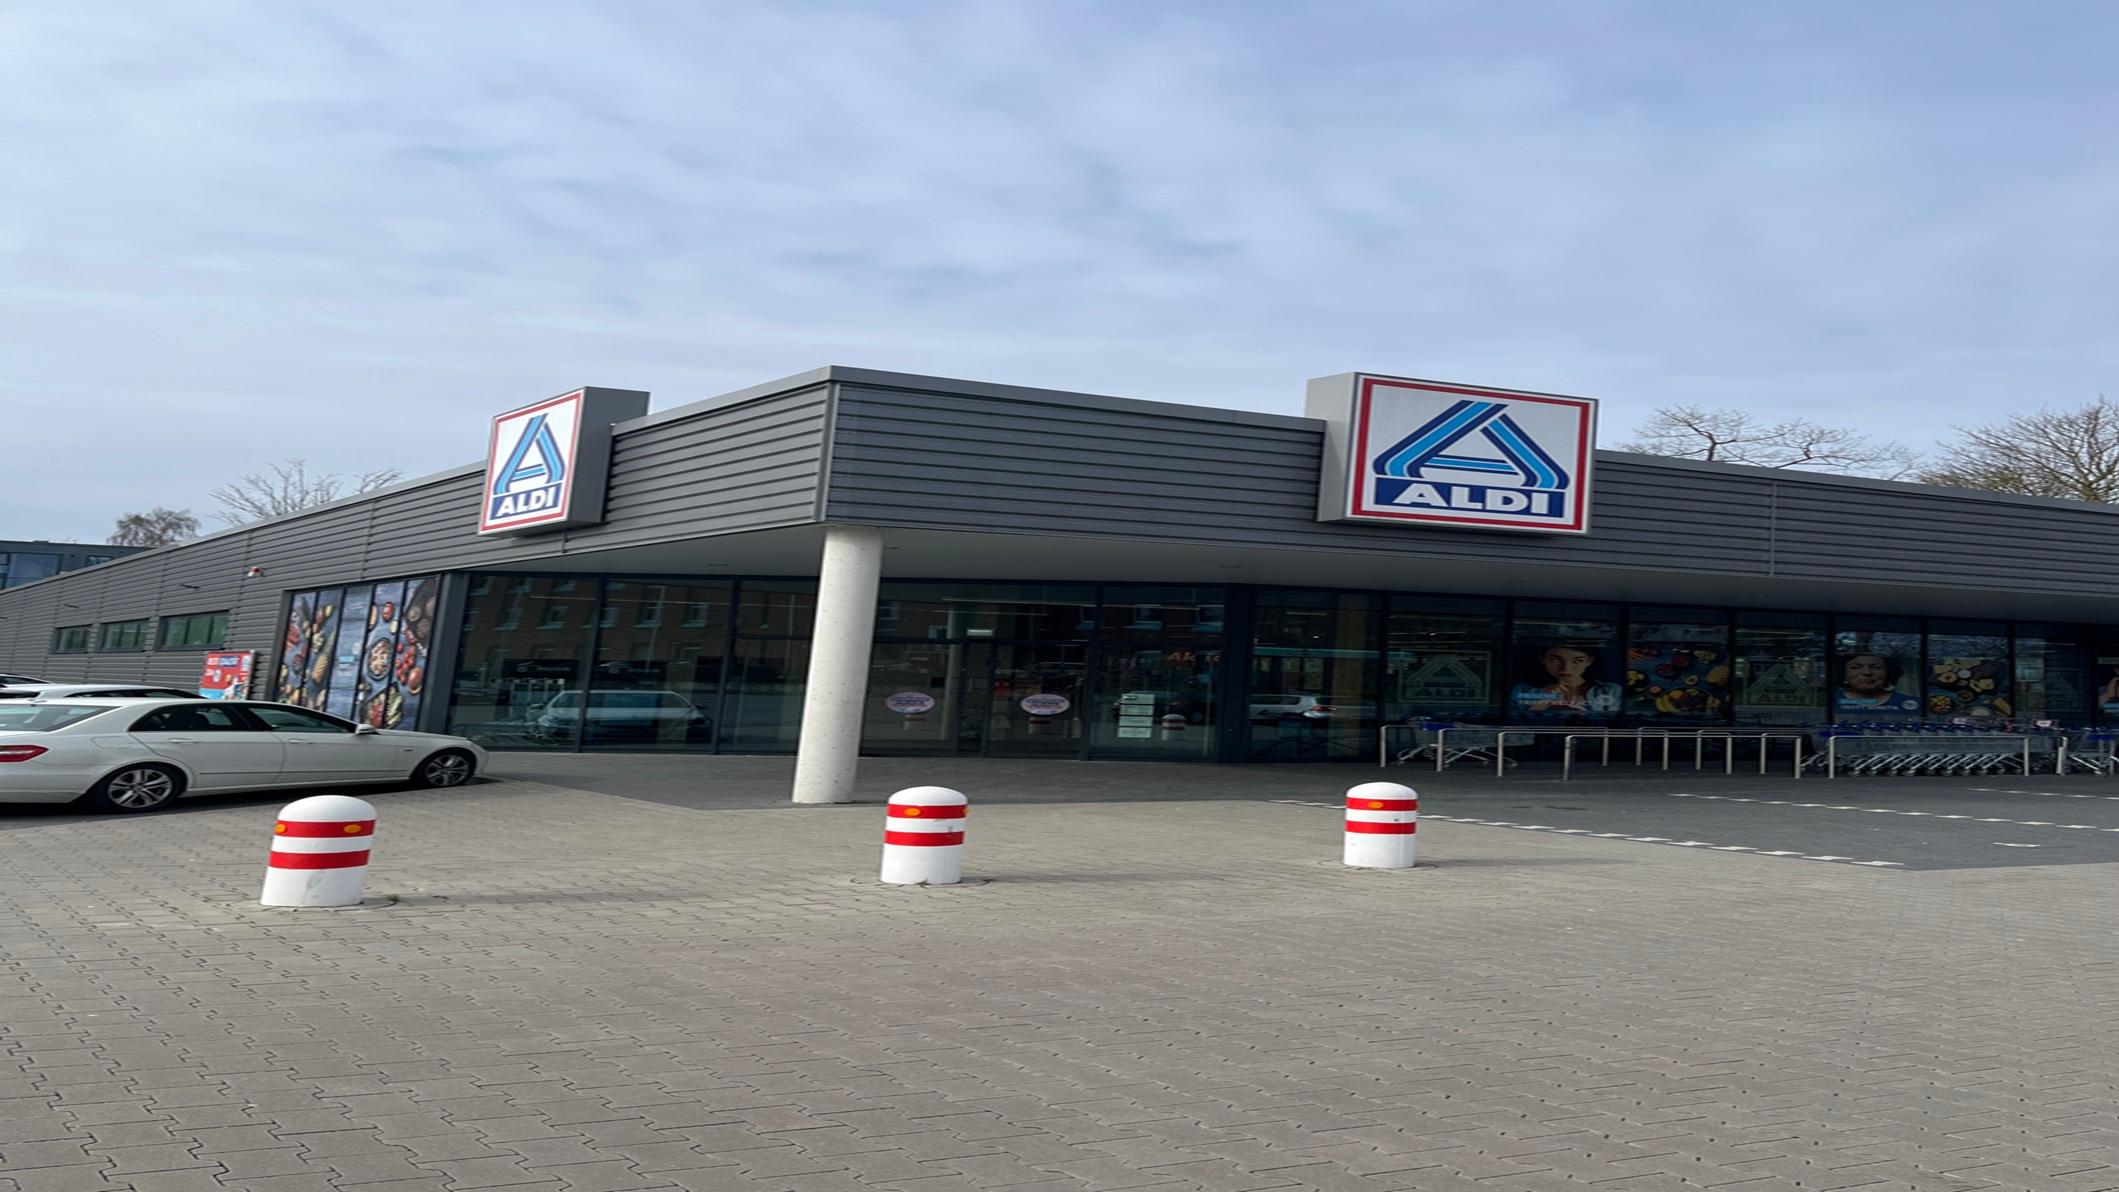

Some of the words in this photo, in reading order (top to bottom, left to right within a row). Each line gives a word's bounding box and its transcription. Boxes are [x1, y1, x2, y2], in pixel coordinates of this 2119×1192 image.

[495, 485, 556, 517] ALDI
[1391, 483, 1549, 514] ALDI
[1414, 688, 1475, 697] ALDI
